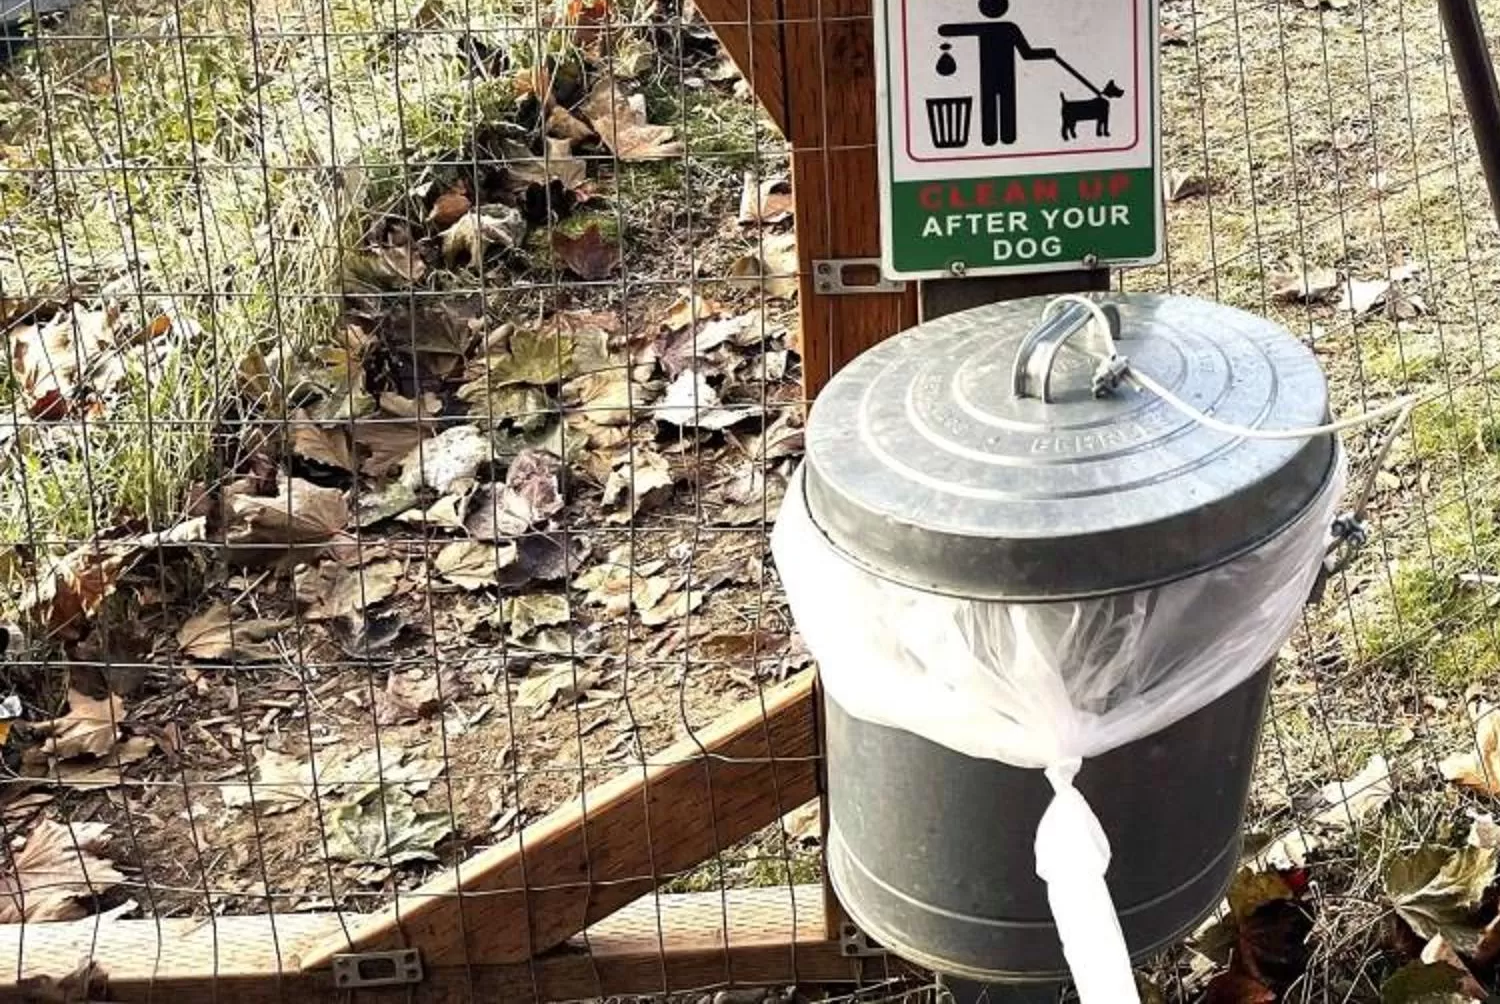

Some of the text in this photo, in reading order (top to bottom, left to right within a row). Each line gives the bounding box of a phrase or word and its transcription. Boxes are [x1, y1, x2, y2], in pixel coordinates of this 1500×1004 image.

[919, 174, 1131, 210] CLEAN UP
[922, 205, 1130, 237] AFTER YOUR
[993, 236, 1062, 260] DOG
